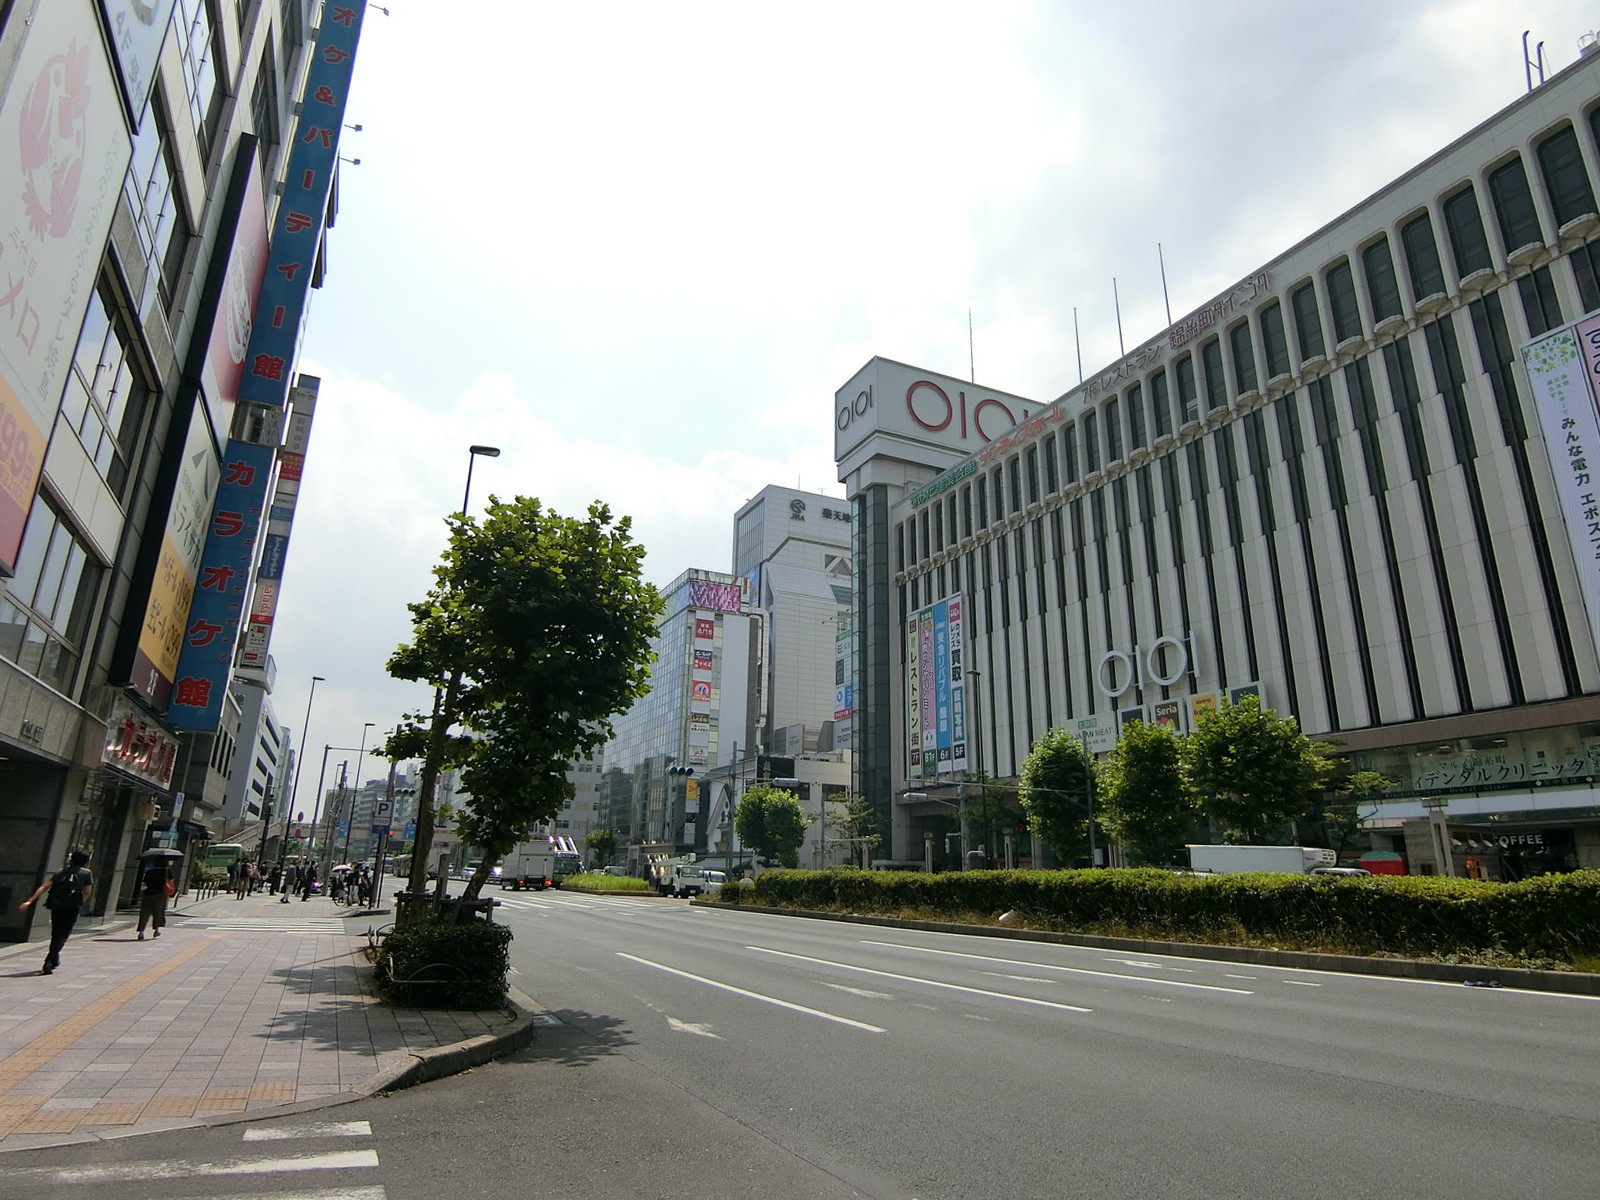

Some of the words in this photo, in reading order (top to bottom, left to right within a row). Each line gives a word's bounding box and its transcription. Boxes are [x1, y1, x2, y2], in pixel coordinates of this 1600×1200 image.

[252, 6, 357, 380] オケ&パーティー館
[1101, 345, 1161, 391] レストラン
[1561, 417, 1591, 487] みんな電力
[791, 513, 805, 521] JRA
[173, 460, 256, 708] カラオケ館
[910, 652, 920, 746] レストラン街
[1156, 704, 1177, 716] Seria
[1074, 731, 1094, 740] JAAN
[1095, 727, 1112, 738] MEAT
[912, 752, 919, 761] 7F
[955, 747, 963, 756] 5F
[1382, 758, 1584, 789] ティデンタルクリニック
[379, 803, 388, 815] P
